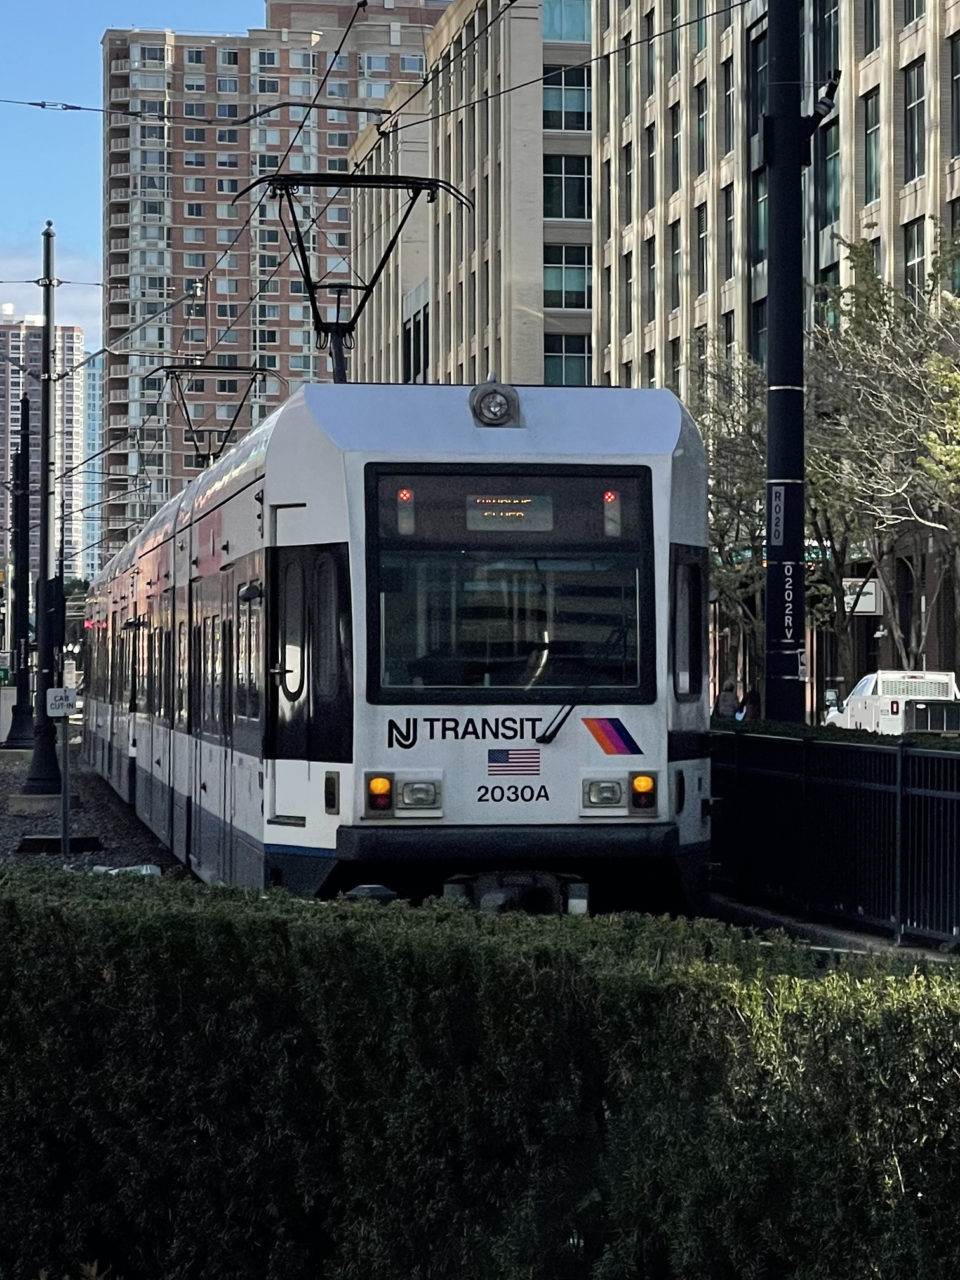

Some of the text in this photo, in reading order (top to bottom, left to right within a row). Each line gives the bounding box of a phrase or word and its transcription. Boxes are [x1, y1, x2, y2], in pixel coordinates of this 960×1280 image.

[784, 565, 793, 639] 0202RV
[50, 702, 74, 710] CUT-IN
[387, 717, 543, 749] NJ TRANSIT
[477, 785, 550, 802] 2030A
